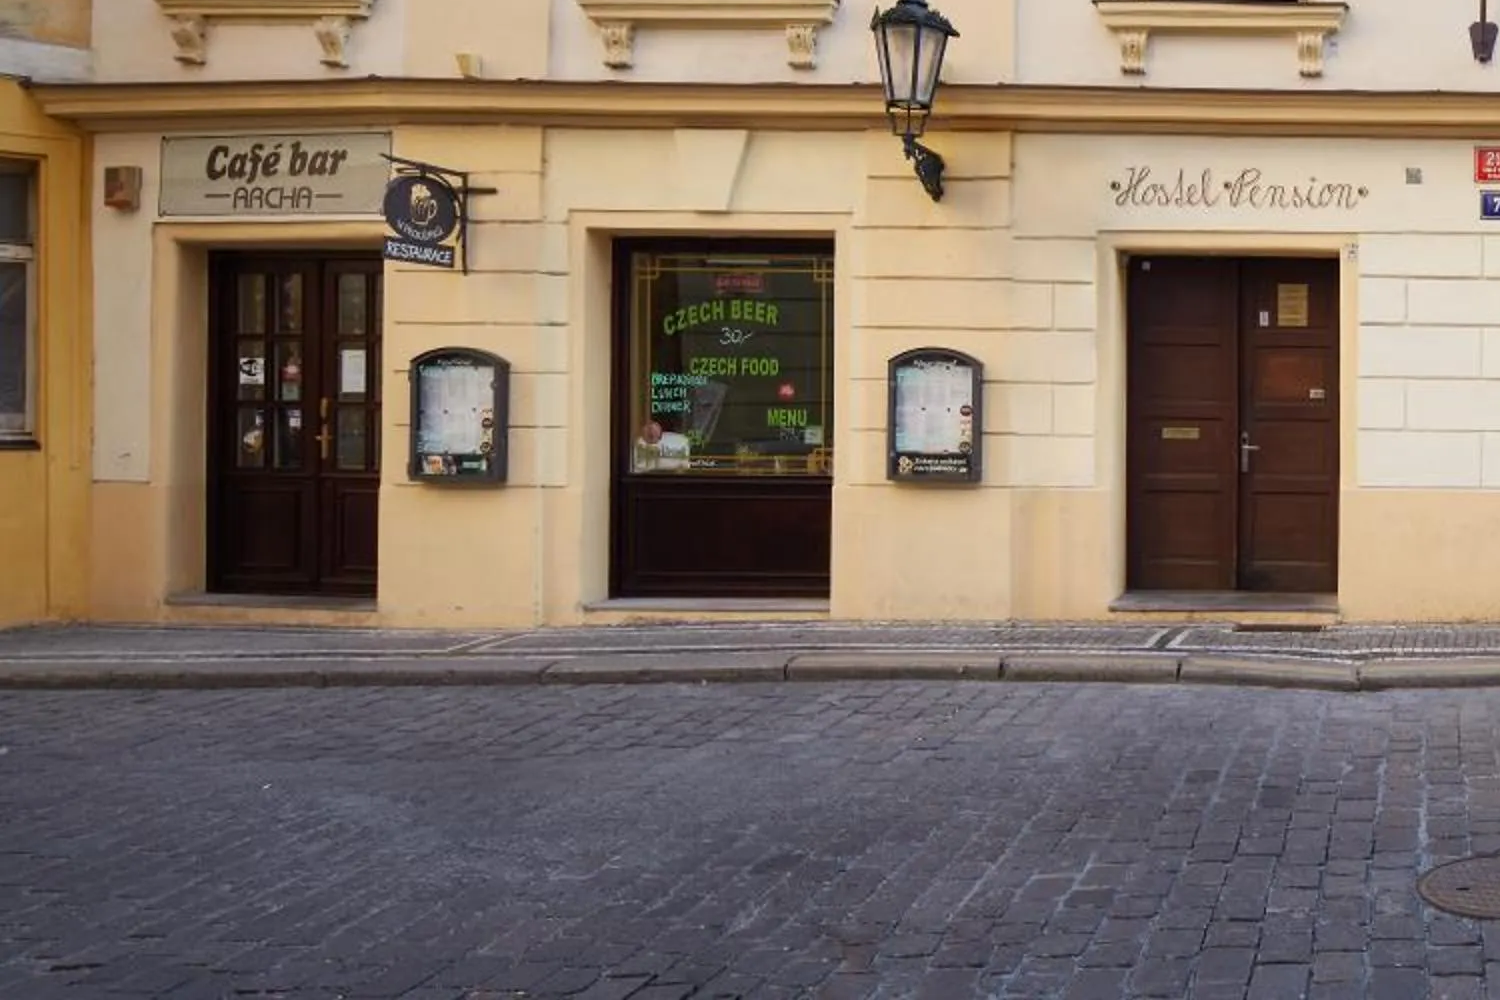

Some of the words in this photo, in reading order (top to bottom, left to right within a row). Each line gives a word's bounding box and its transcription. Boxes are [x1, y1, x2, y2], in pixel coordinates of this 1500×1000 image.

[206, 143, 284, 184] Café
[289, 141, 347, 176] bar
[1115, 166, 1220, 208] Hostel
[1229, 167, 1359, 209] Pension
[386, 240, 453, 264] RESTAURACE
[663, 299, 724, 336] CZECH
[730, 299, 780, 326] BEER
[690, 357, 737, 377] CZECH
[741, 357, 780, 376] FOOD
[767, 409, 807, 427] MENU
